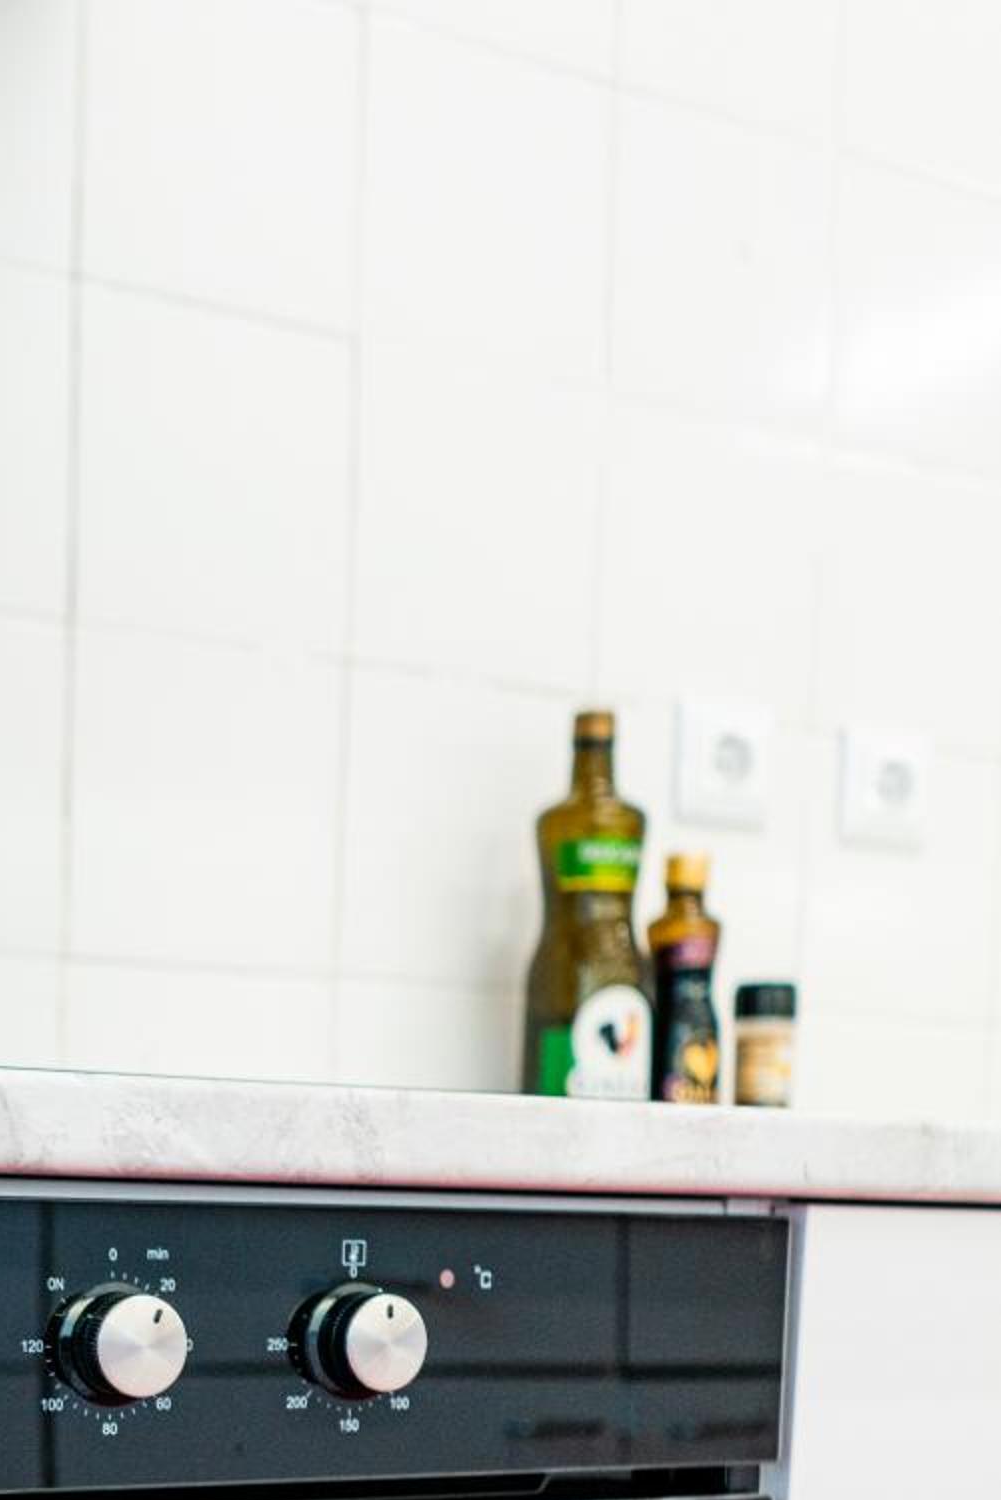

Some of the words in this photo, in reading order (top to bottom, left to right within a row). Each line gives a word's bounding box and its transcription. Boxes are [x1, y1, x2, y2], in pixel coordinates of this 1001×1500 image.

[146, 1247, 169, 1260] min
[160, 1279, 176, 1292] 20
[22, 1340, 43, 1353] 120
[267, 1340, 288, 1352] 250
[42, 1399, 63, 1412] 100
[287, 1397, 307, 1409] 200
[390, 1397, 410, 1410] 100
[102, 1422, 117, 1436] 80
[340, 1420, 359, 1432] 150
